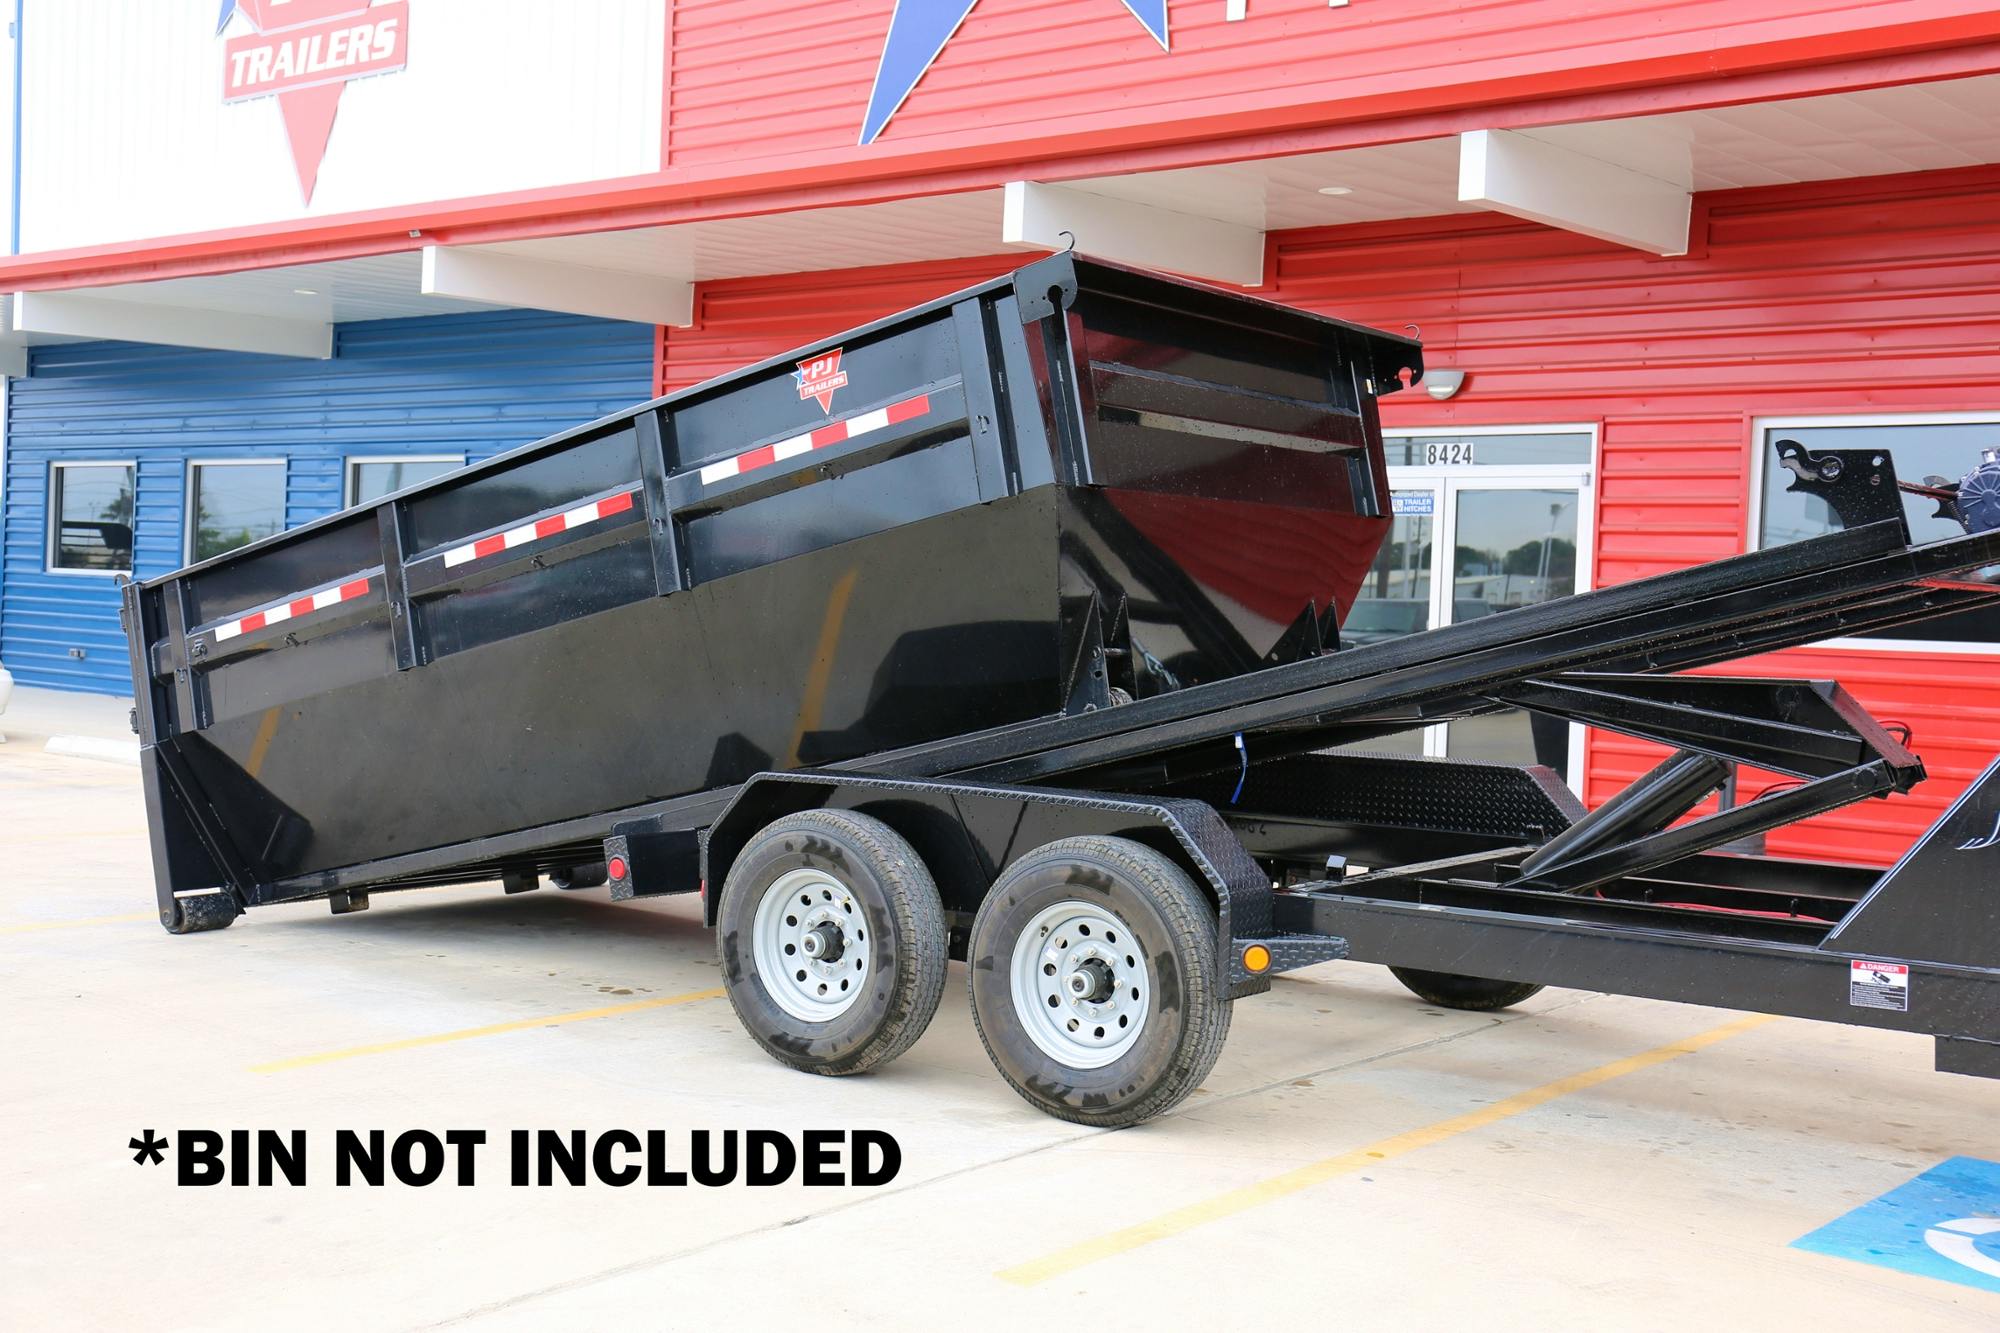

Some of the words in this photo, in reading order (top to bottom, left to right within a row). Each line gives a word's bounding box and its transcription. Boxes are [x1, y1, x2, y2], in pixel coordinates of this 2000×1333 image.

[231, 18, 399, 88] TRAILERS
[811, 356, 833, 379] PJ
[803, 375, 845, 396] TRAILERS
[1427, 444, 1473, 465] 8424
[1403, 498, 1432, 506] TRAILER
[1403, 505, 1432, 513] HITCHES
[1867, 963, 1900, 973] DANGER
